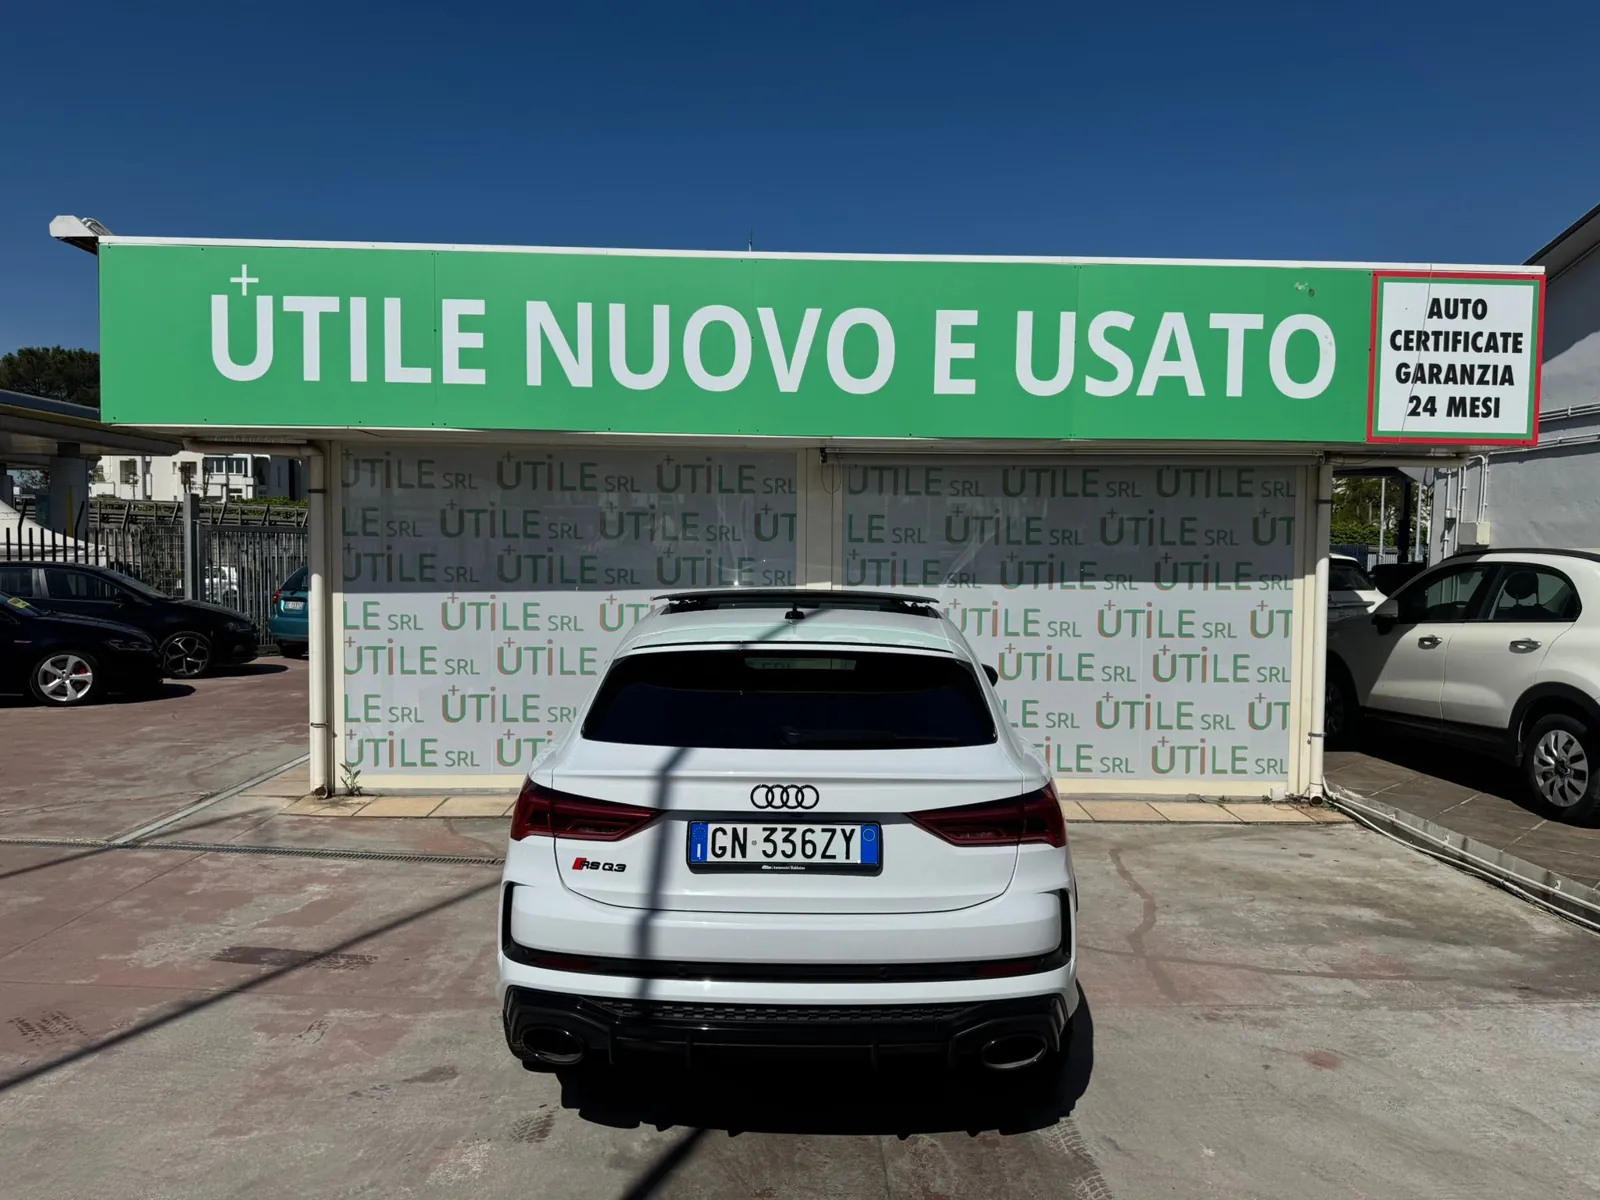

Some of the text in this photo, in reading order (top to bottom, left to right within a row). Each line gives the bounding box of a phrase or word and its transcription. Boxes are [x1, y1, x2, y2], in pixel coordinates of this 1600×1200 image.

[1427, 297, 1488, 320] AUTO
[526, 301, 896, 395] NUOVO
[933, 309, 978, 395] E
[1014, 310, 1337, 399] USATO
[1390, 329, 1523, 353] CERTIFICATE
[1395, 362, 1514, 386] GARANZIA
[1407, 396, 1500, 418] 24 MESI
[441, 473, 478, 489] SRL
[604, 475, 641, 492] SRL
[762, 477, 796, 494] SRL
[949, 480, 985, 497] SRL
[1105, 481, 1142, 497] SRL
[1261, 481, 1296, 497] SRL
[386, 520, 422, 537] SRL
[548, 522, 583, 539] SRL
[706, 525, 742, 541] SRL
[892, 527, 928, 544] SRL
[1049, 529, 1085, 545] SRL
[1204, 529, 1240, 545] SRL
[444, 566, 479, 583] SRL
[604, 568, 640, 585] SRL
[762, 570, 796, 586] SRL
[947, 573, 982, 589] SRL
[1103, 574, 1138, 590] SRL
[1258, 574, 1293, 590] SRL
[387, 614, 423, 631] SRL
[547, 615, 584, 631] SRL
[1047, 621, 1082, 637] SRL
[1201, 622, 1237, 638] SRL
[444, 659, 480, 675] SRL
[1101, 666, 1136, 682] SRL
[1256, 667, 1291, 682] SRL
[388, 706, 424, 723] SRL
[1045, 712, 1080, 729] SRL
[1200, 714, 1236, 730] SRL
[444, 750, 480, 767] SRL
[1100, 757, 1135, 773] SRL
[1254, 758, 1288, 774] SRL
